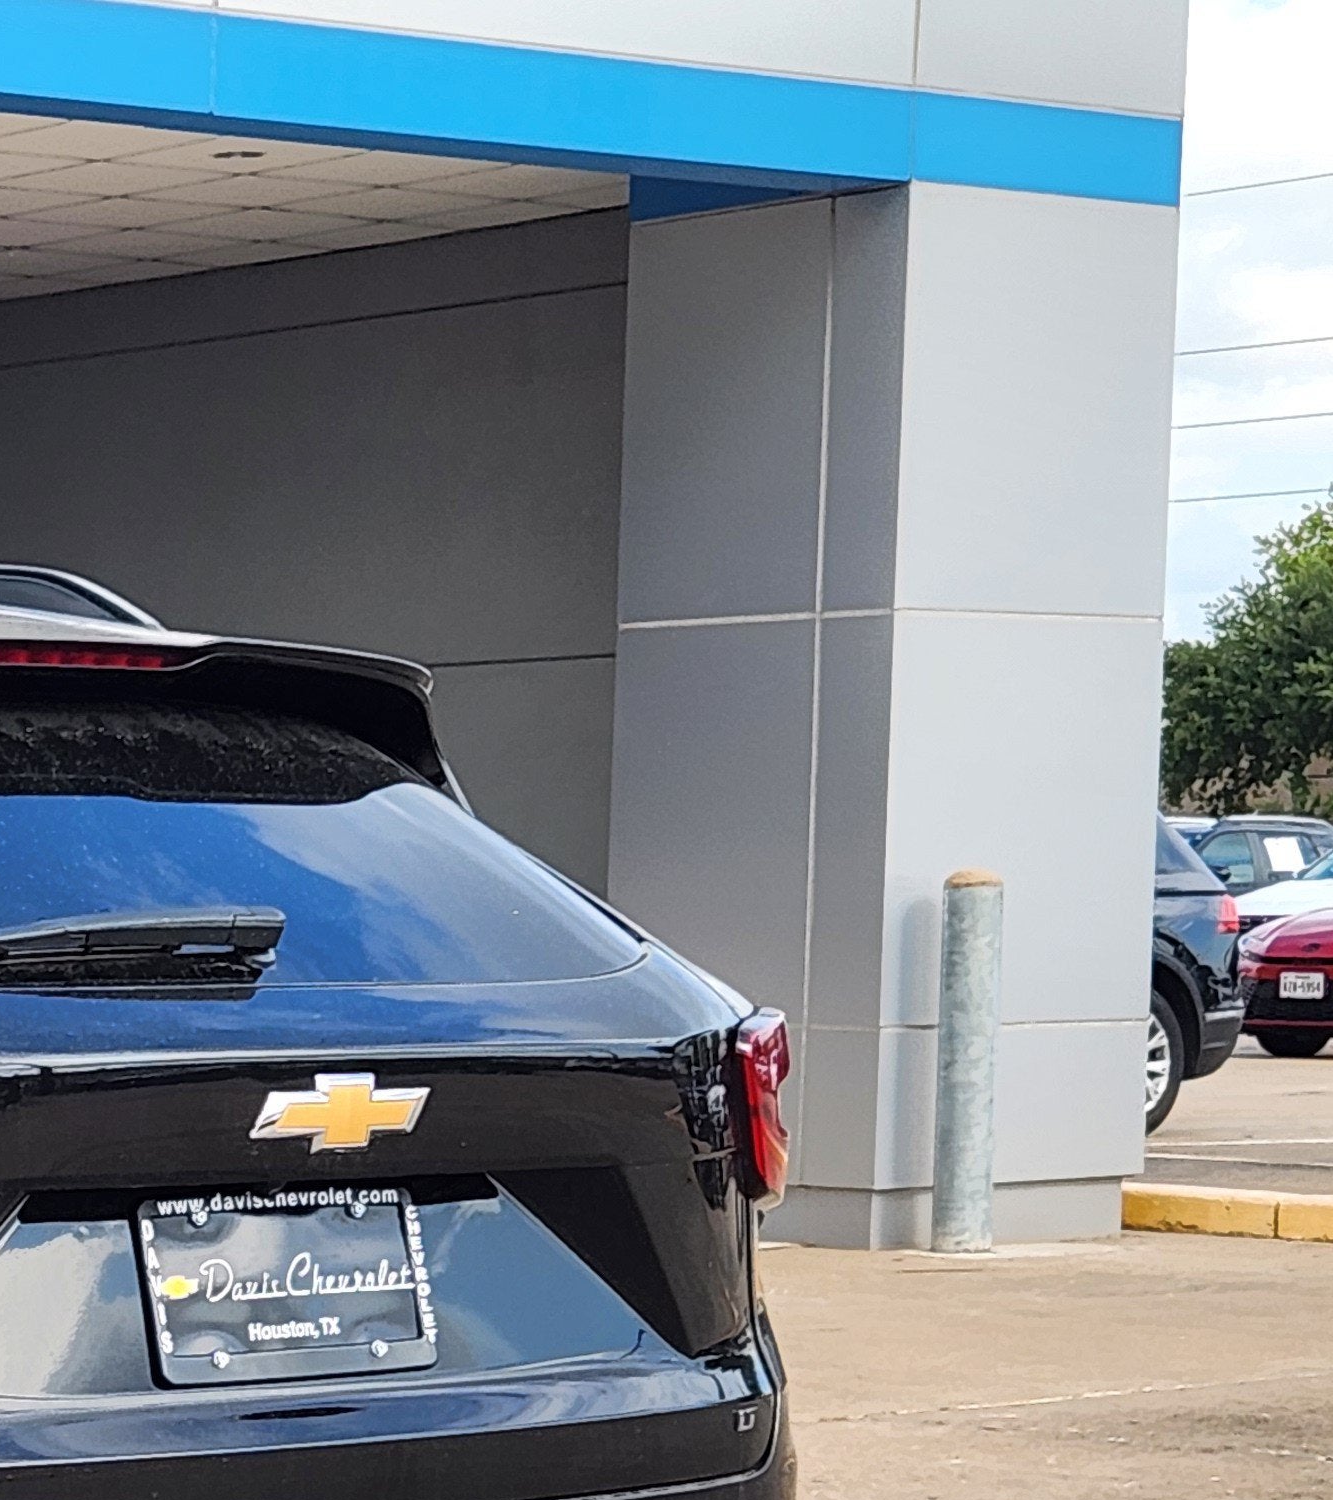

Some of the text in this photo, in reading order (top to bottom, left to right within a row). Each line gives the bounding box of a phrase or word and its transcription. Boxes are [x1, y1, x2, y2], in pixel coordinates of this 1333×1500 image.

[141, 1219, 174, 1354] DAVIS
[199, 1252, 416, 1303] Davis Chevrolet
[405, 1205, 438, 1344] CHEVROLET
[247, 1316, 341, 1341] Houston, TX
